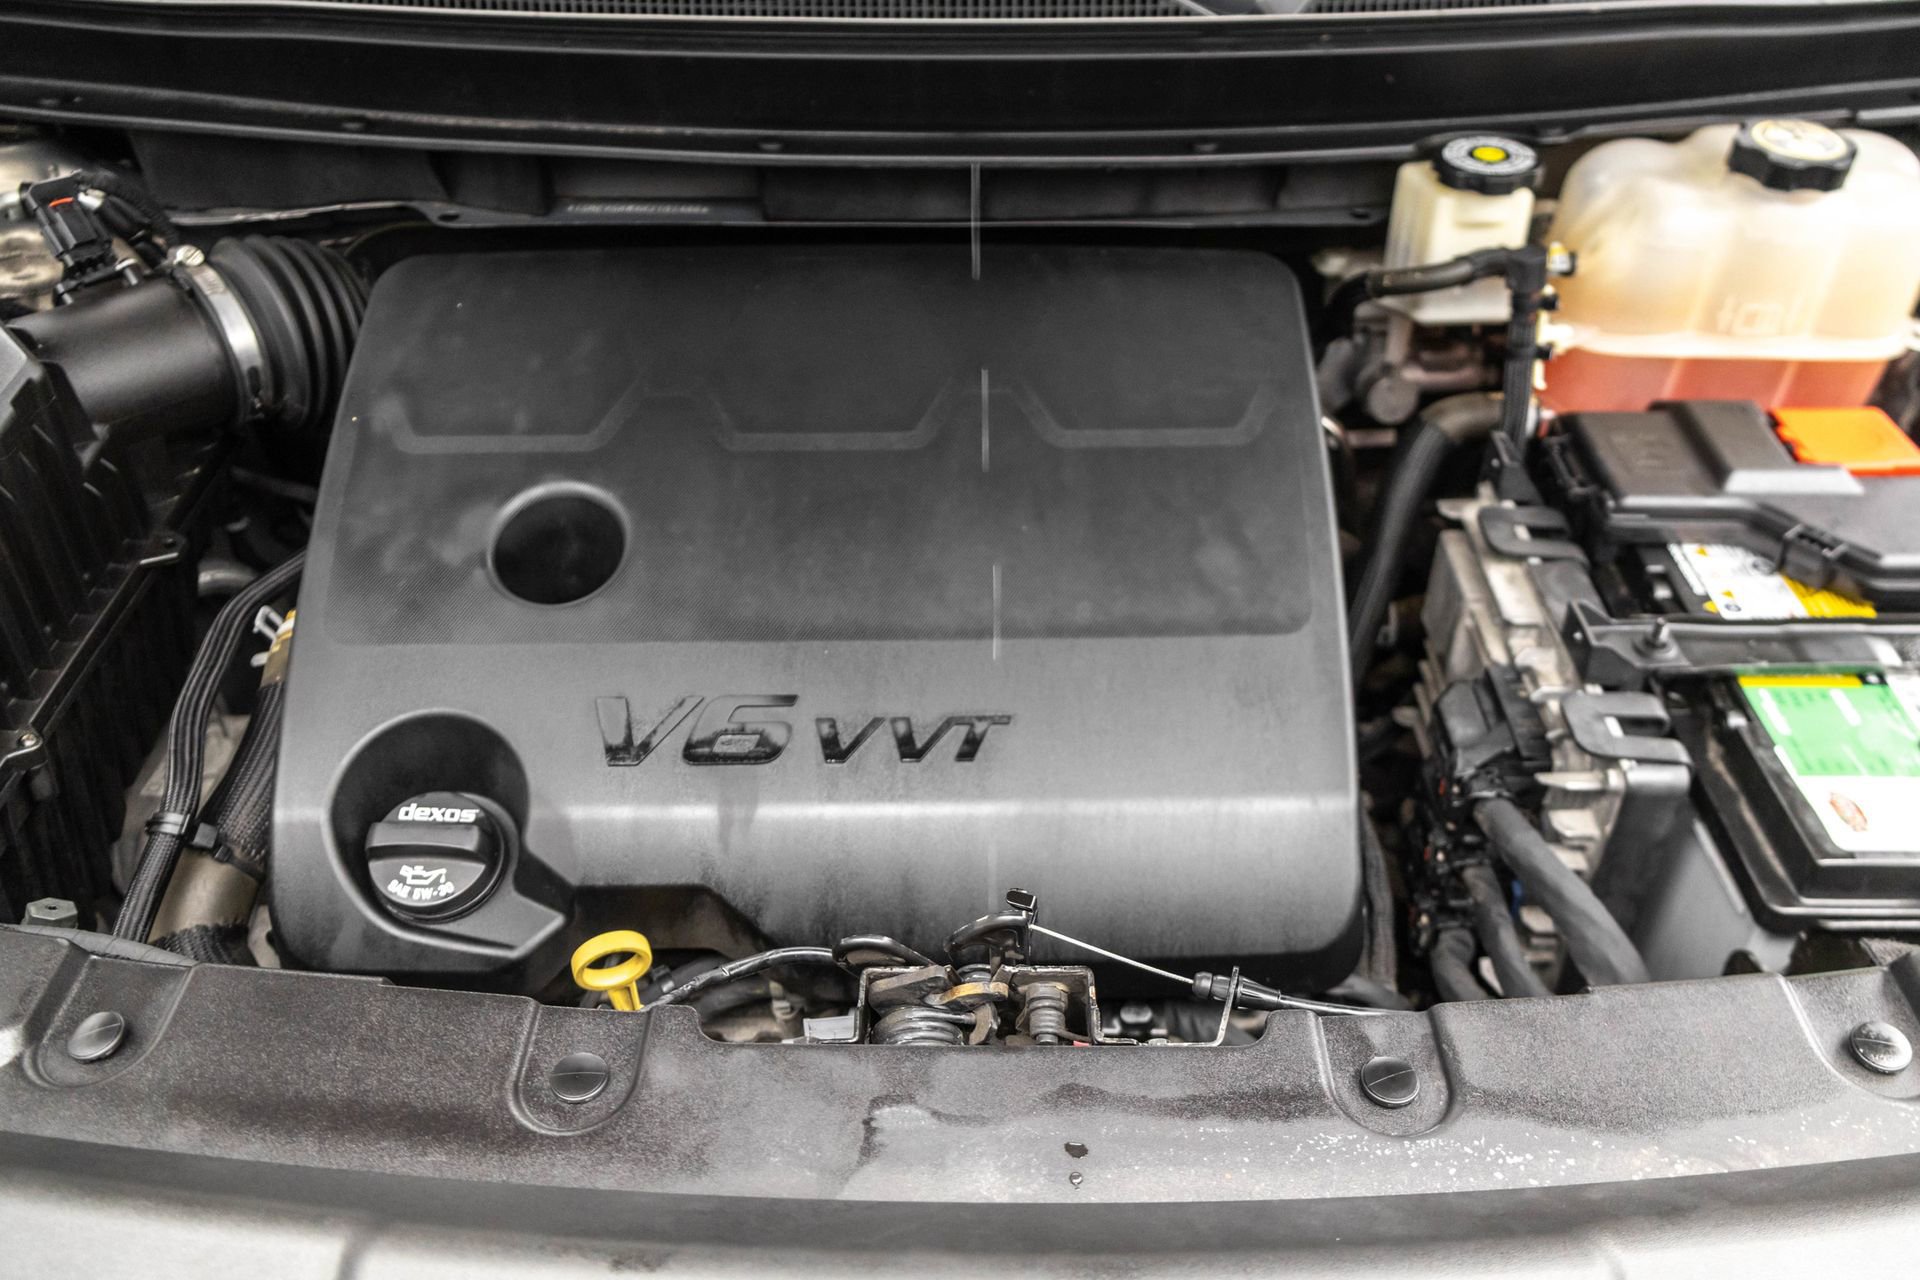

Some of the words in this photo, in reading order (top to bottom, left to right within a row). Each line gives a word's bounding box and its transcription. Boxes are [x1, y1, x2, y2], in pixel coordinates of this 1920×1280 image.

[594, 693, 800, 767] V6
[814, 714, 1013, 764] VVT
[398, 804, 479, 822] dexos
[388, 880, 410, 898] SAE
